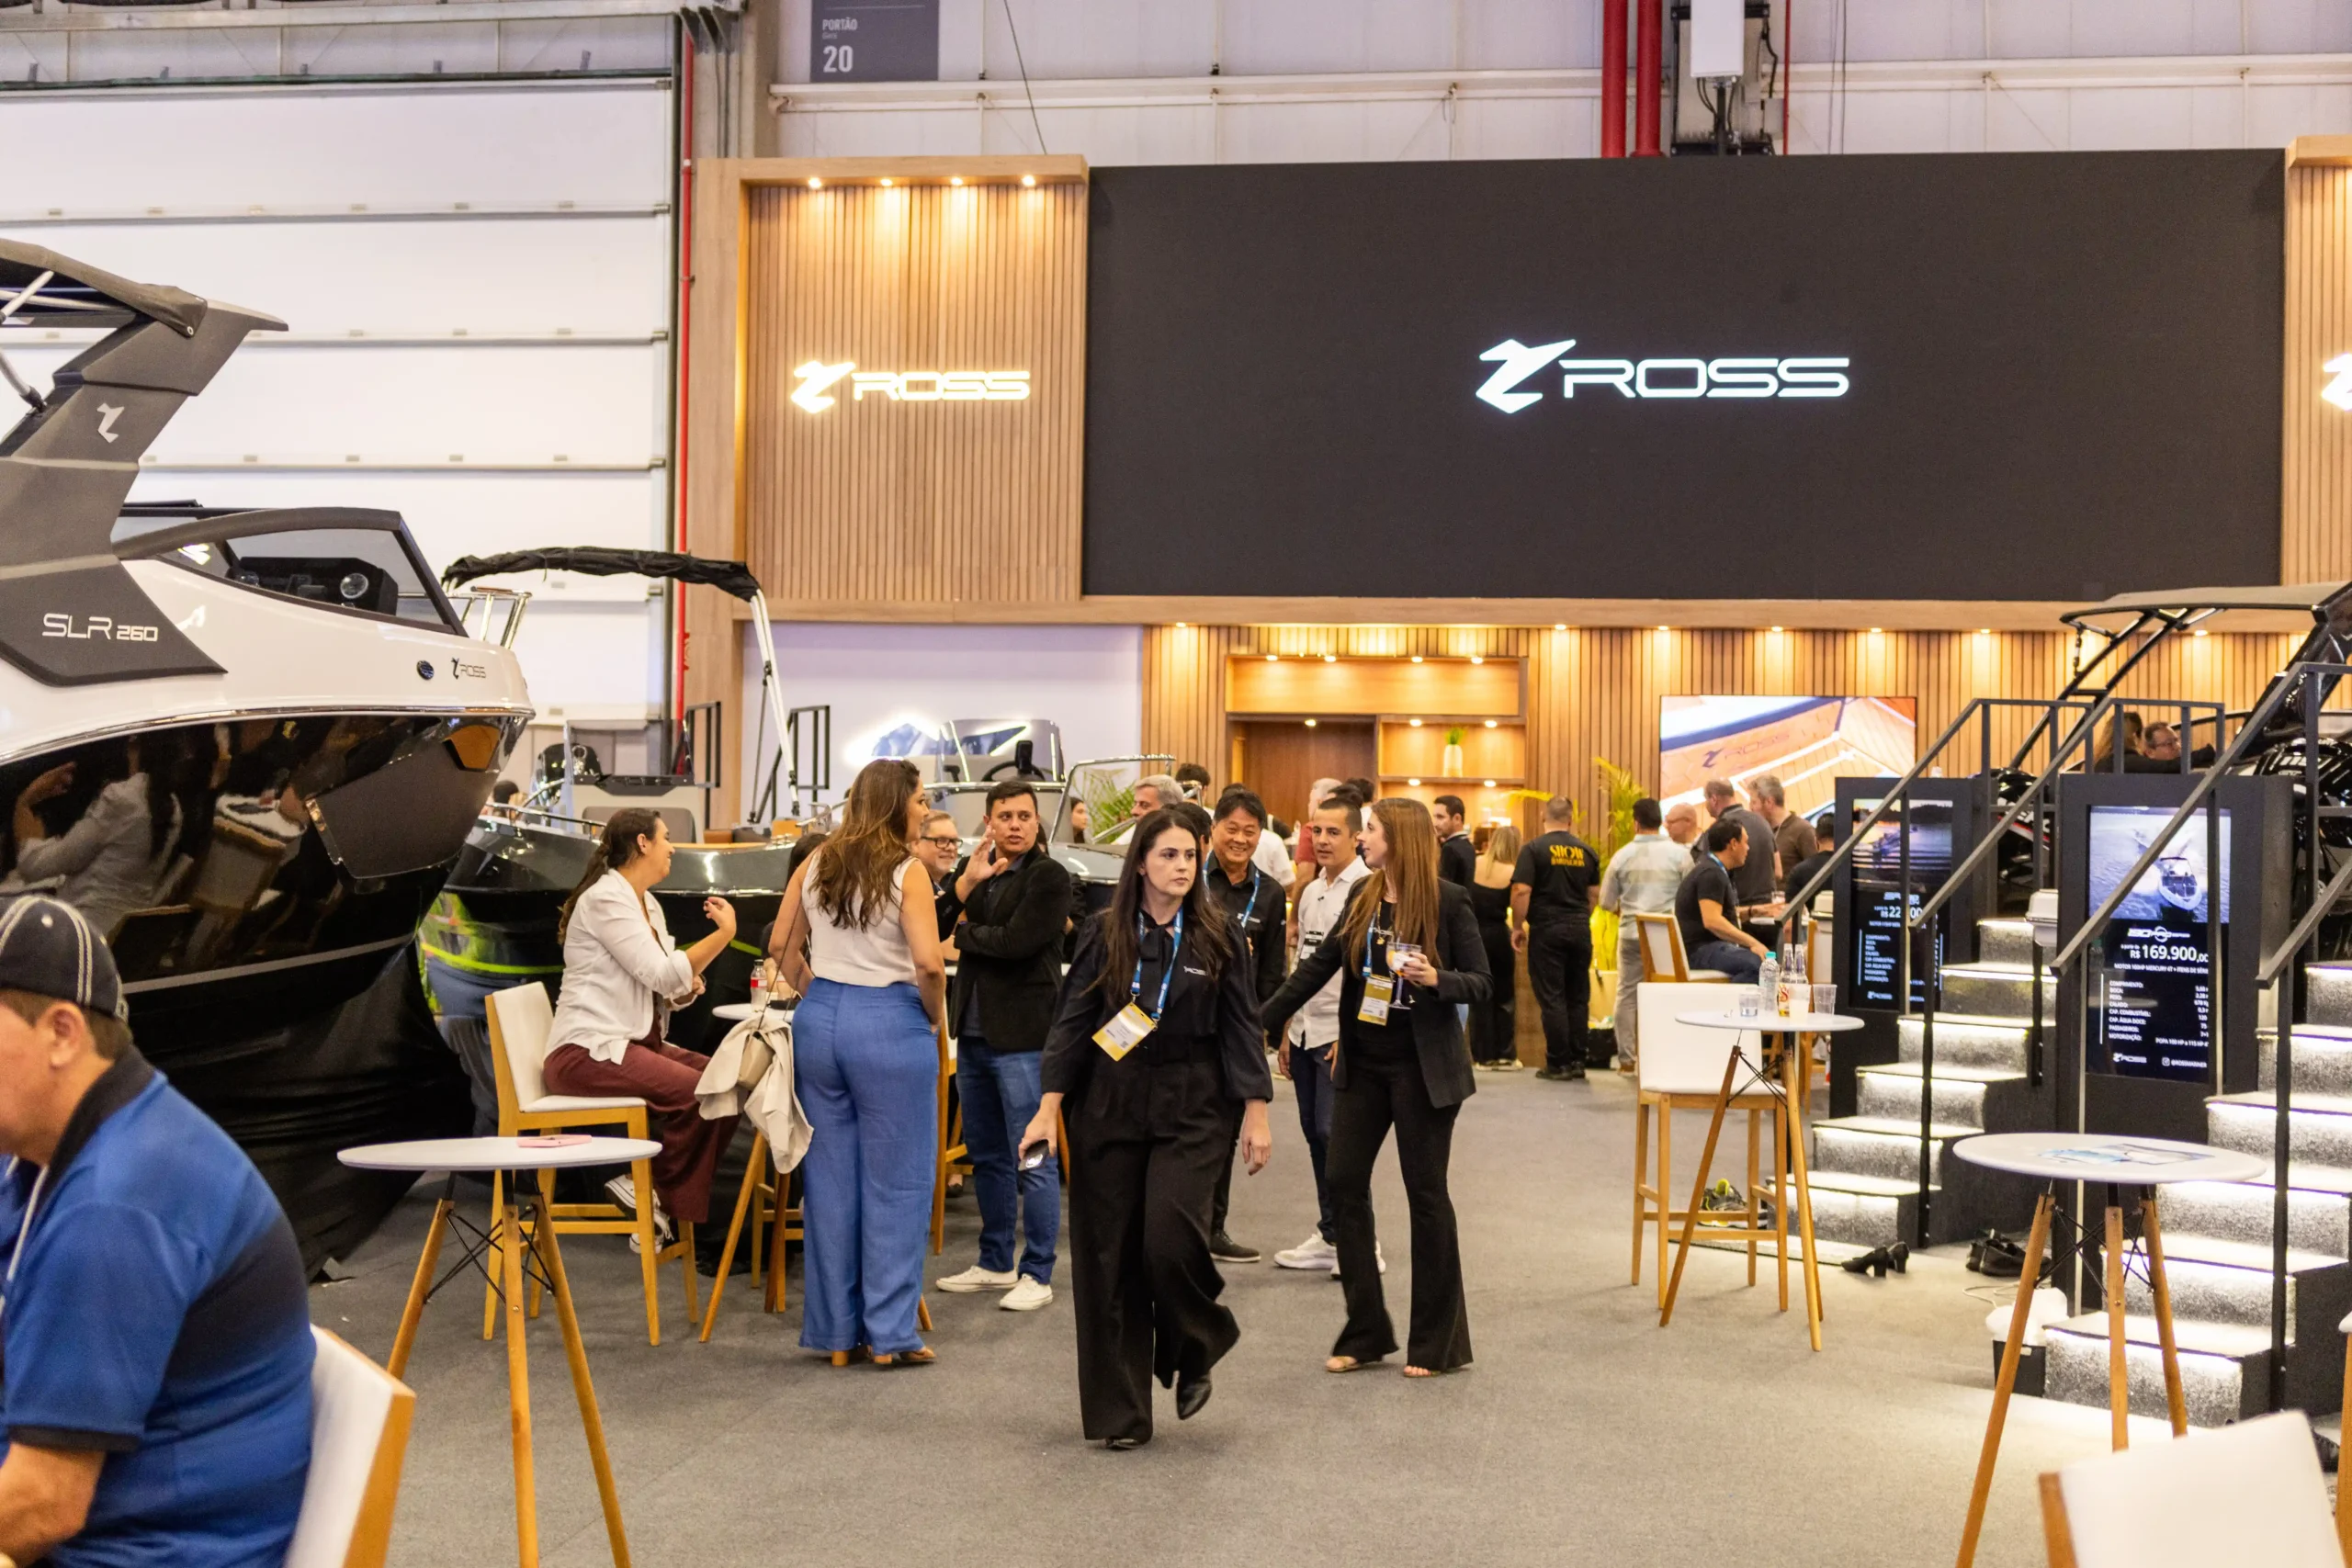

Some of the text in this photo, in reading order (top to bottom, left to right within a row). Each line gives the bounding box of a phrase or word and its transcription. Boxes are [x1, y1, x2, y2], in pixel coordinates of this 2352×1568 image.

[822, 17, 858, 30] PORTÃO
[823, 45, 854, 73] 20
[852, 371, 1030, 401] ROSS
[1559, 357, 1849, 399] ROSS
[42, 613, 159, 642] SLR 260
[2130, 950, 2141, 959] R$
